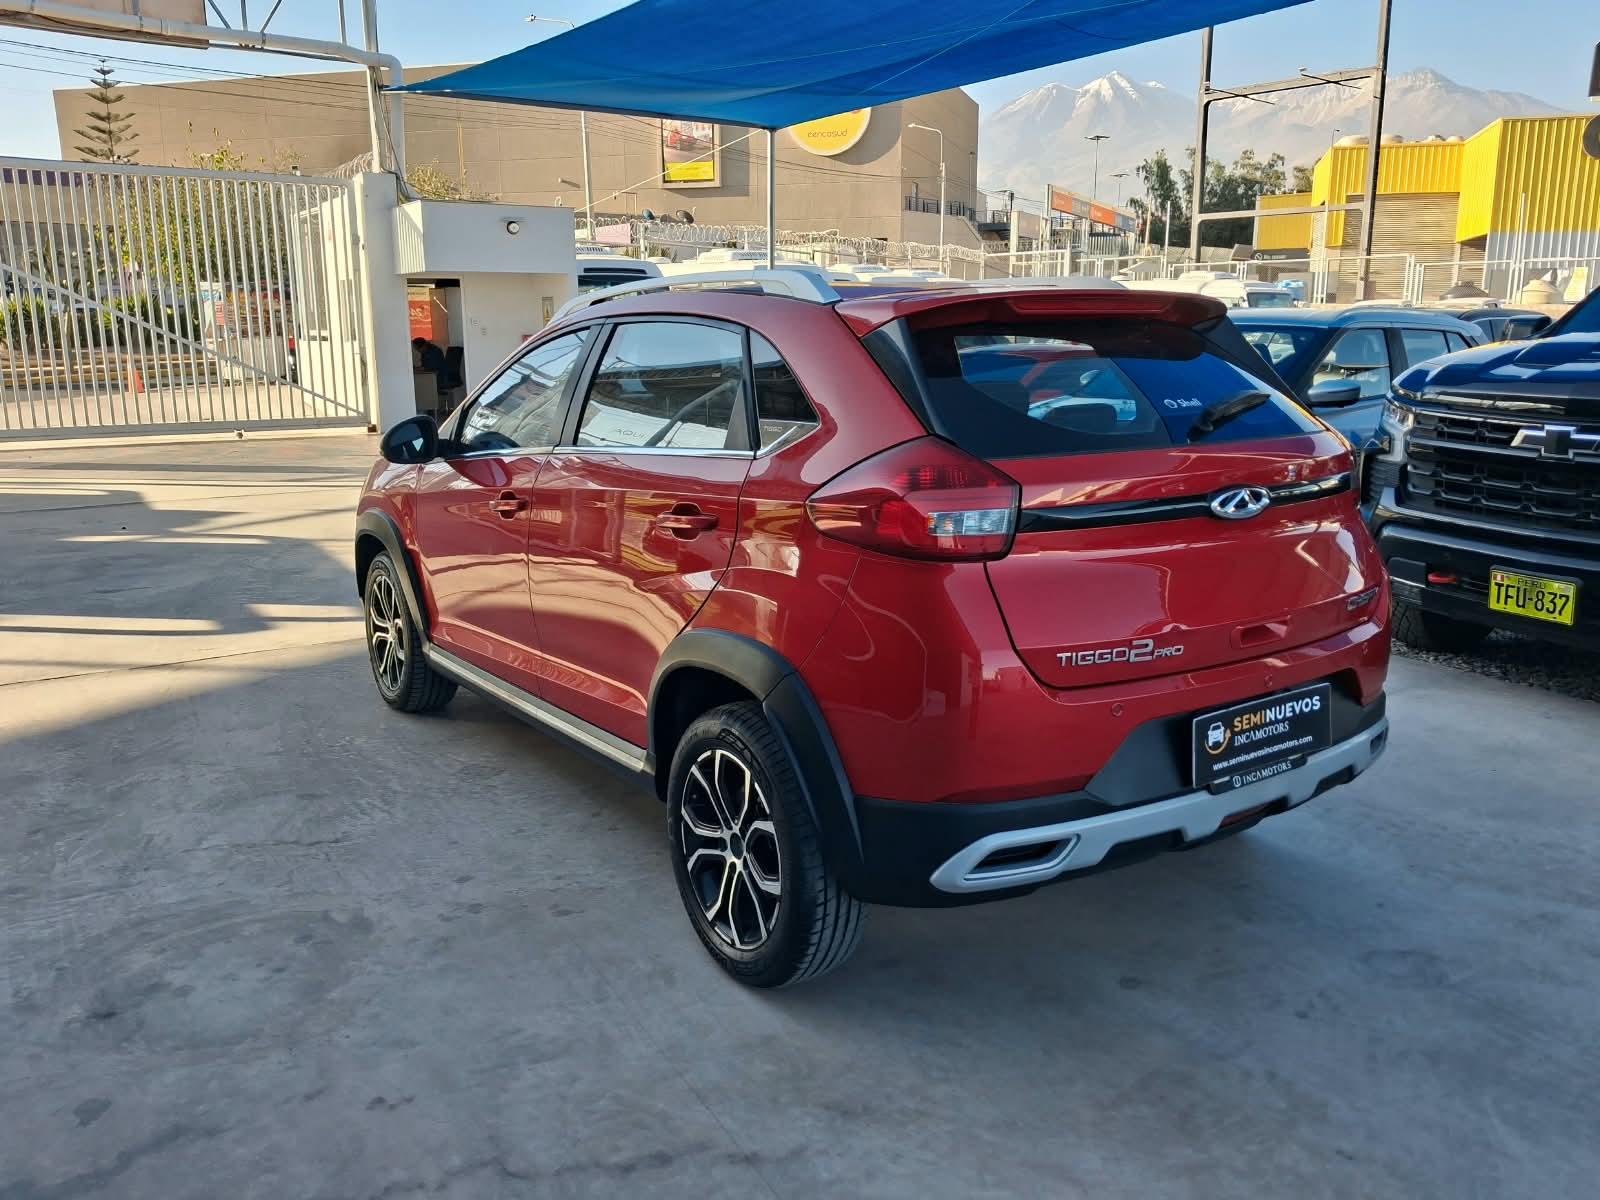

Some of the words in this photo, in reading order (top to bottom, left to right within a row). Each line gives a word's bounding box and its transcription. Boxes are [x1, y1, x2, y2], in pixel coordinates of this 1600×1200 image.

[1494, 581, 1570, 616] TFU-837
[1233, 695, 1321, 732] SEMINUEVOS
[1234, 721, 1289, 746] INCAMOTORS
[1212, 735, 1313, 771] www.seminuevosincamotors.com
